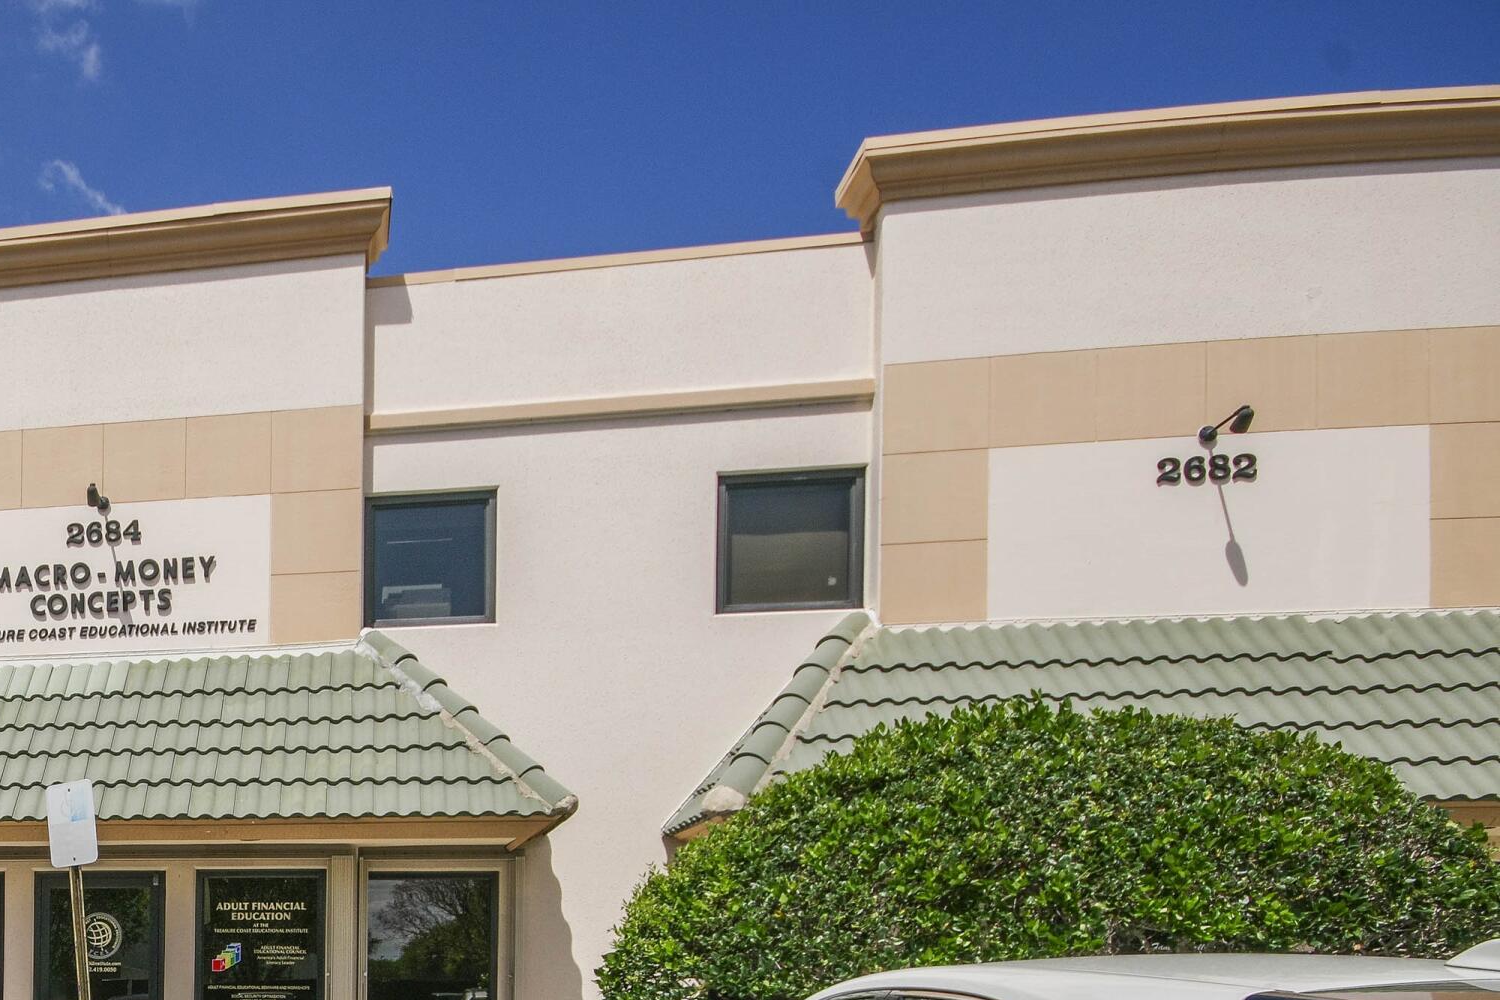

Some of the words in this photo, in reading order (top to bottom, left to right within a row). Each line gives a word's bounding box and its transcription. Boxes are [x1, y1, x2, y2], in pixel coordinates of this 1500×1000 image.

[1156, 453, 1257, 486] 2682
[66, 520, 142, 545] 2684
[114, 556, 216, 583] MONEY
[30, 588, 172, 617] CONCEPTS
[28, 626, 76, 642] COAST
[79, 622, 178, 640] EDUCATIONAL
[182, 619, 257, 636] INSTITUTE
[216, 902, 249, 910] ADULT
[252, 902, 307, 911] FINANCIAL
[231, 912, 291, 920] EDUCATION
